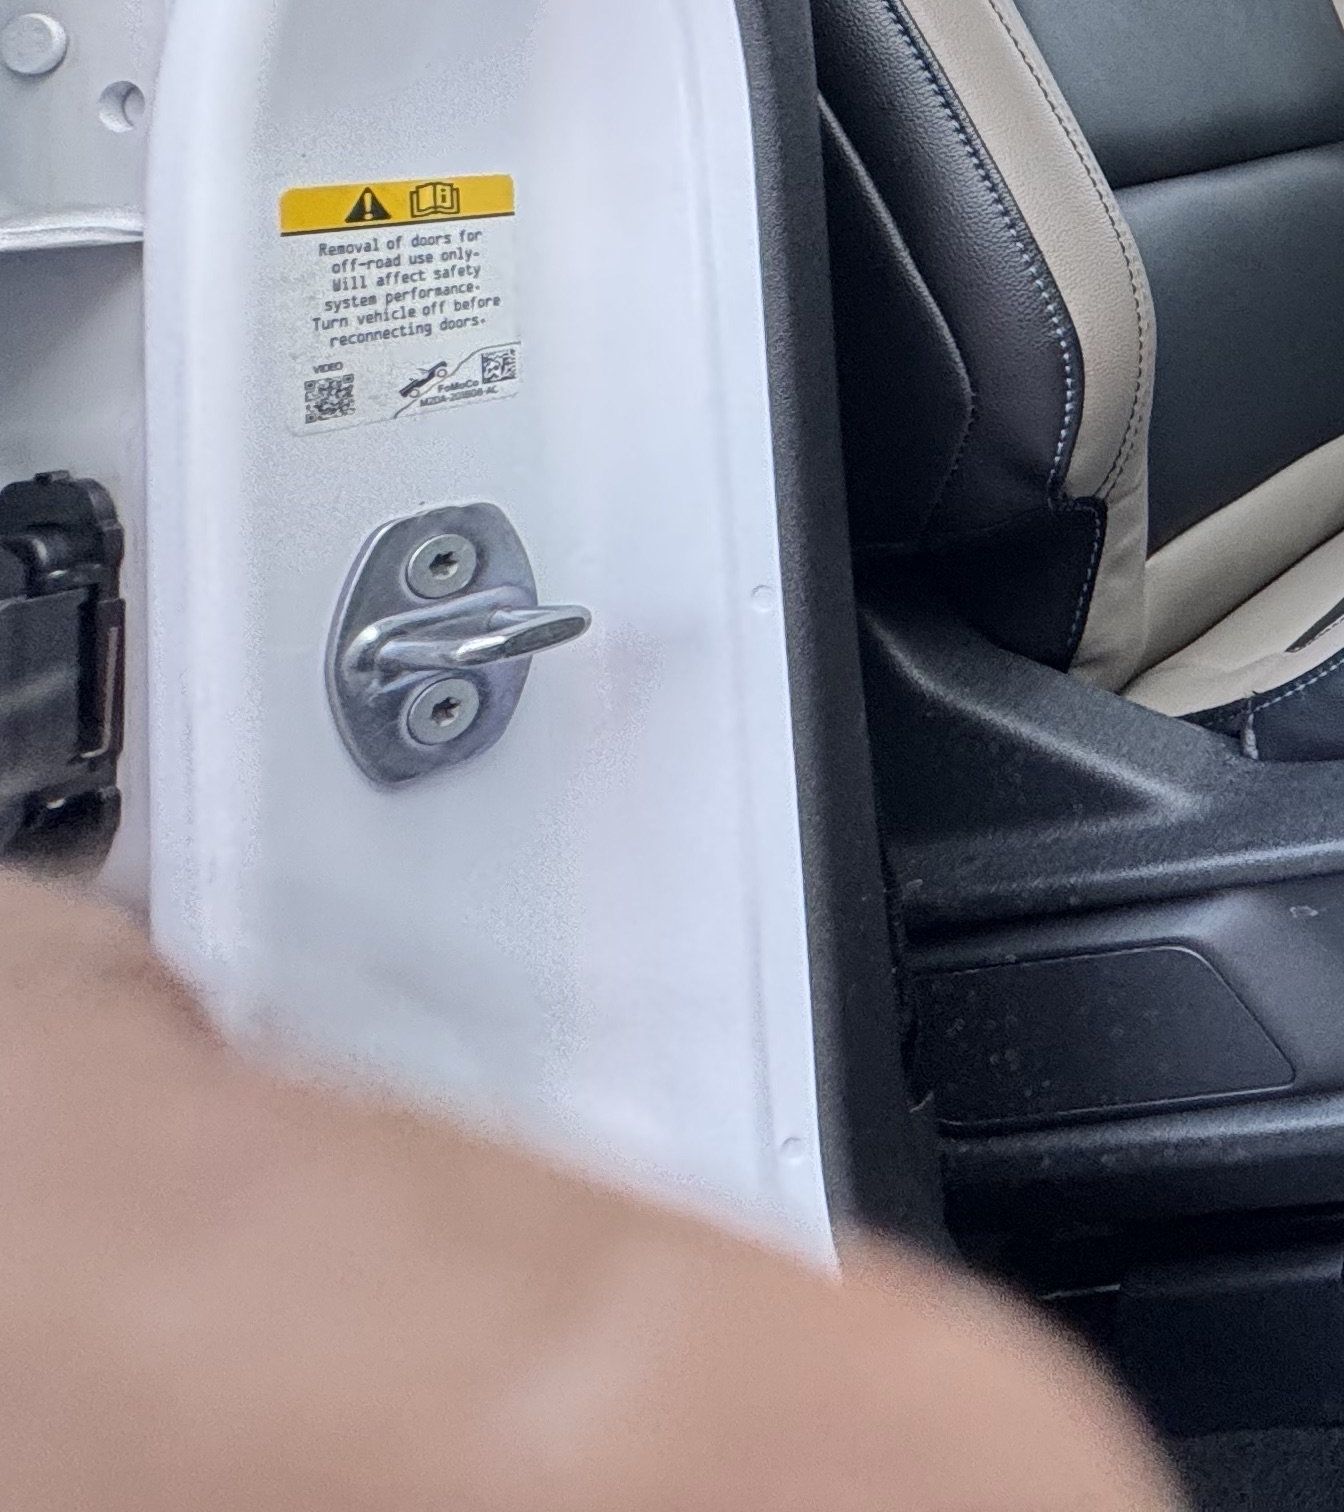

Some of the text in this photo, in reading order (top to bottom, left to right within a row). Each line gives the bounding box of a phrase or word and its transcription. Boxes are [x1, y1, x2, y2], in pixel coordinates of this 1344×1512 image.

[319, 229, 483, 257] Removal of doors for
[331, 254, 401, 274] off-road
[409, 252, 434, 265] use
[332, 264, 481, 292] Will affect safety
[324, 281, 481, 314] system performance.
[312, 295, 501, 332] Turn vehicle off before
[329, 315, 487, 348] reconnecting doors.
[312, 361, 344, 374] VIDEO
